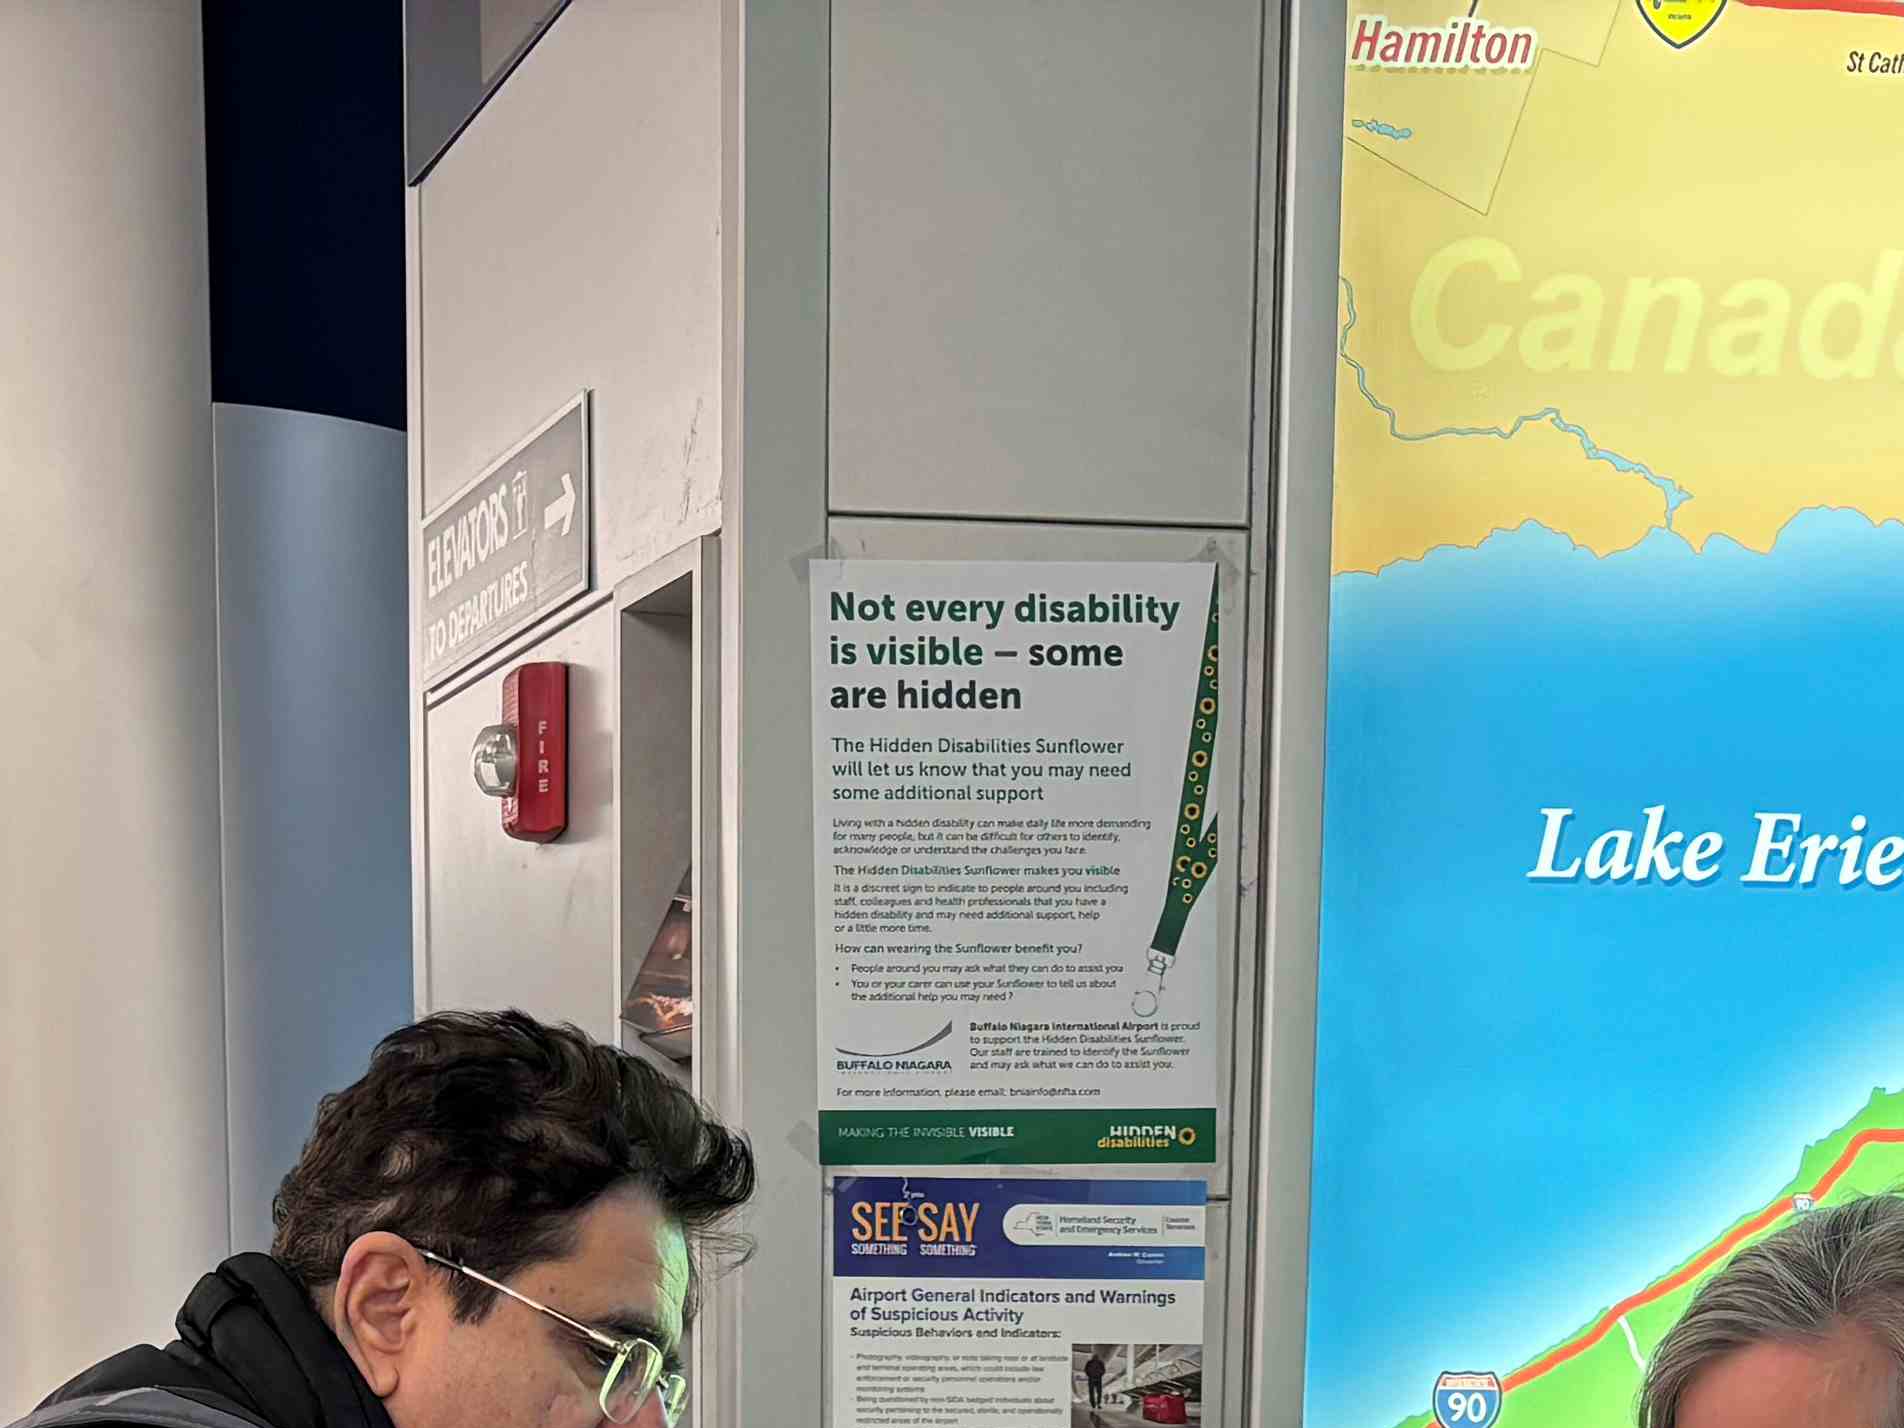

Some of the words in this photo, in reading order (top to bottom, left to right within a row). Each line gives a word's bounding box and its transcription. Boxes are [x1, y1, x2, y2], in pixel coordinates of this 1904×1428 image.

[1352, 19, 1534, 66] Hamilton
[1847, 52, 1866, 74] St
[428, 484, 508, 599] ELEVATORS
[427, 621, 447, 660] TO
[448, 562, 528, 649] DEPARTURES
[830, 592, 896, 622] Not
[906, 598, 1003, 629] every
[1015, 593, 1180, 630] disability
[830, 636, 856, 665] is
[867, 636, 983, 665] visible
[1029, 643, 1124, 666] some
[830, 685, 887, 709] are
[898, 680, 1021, 709] hidden
[537, 720, 550, 794] FIRE
[832, 737, 865, 753] The
[869, 737, 932, 753] Hidden
[938, 737, 1031, 754] Disabilities
[1036, 738, 1124, 754] Sunflower
[833, 762, 863, 777] will
[867, 762, 891, 777] let
[895, 765, 914, 777] us
[919, 762, 967, 777] know
[972, 762, 1006, 777] that
[1010, 765, 1043, 782] you
[1048, 765, 1084, 782] may
[1089, 762, 1131, 777] need
[833, 788, 880, 801] some
[884, 786, 971, 801] additional
[976, 787, 1044, 804] support
[1525, 804, 1725, 882] Lake
[837, 1061, 893, 1071] BUFFALO
[896, 1061, 952, 1071] NIAGARA
[839, 1127, 884, 1138] MAKING
[888, 1127, 910, 1138] THE
[913, 1127, 966, 1138] INVISIBLE
[969, 1127, 1014, 1137] VISIBLE
[1098, 1137, 1169, 1149] disabilities
[852, 1202, 908, 1243] SEE
[918, 1202, 979, 1243] SAY
[851, 1243, 907, 1256] SOMETHING
[920, 1244, 976, 1257] SOMETHING
[850, 1288, 908, 1304] Airport
[912, 1288, 975, 1303] General
[980, 1288, 1059, 1304] Indicators
[1064, 1289, 1094, 1304] and
[1099, 1290, 1176, 1308] Warnings
[850, 1307, 868, 1322] of
[871, 1308, 958, 1325] Suspicious
[963, 1308, 1024, 1325] Activity
[1447, 1393, 1487, 1424] 90
